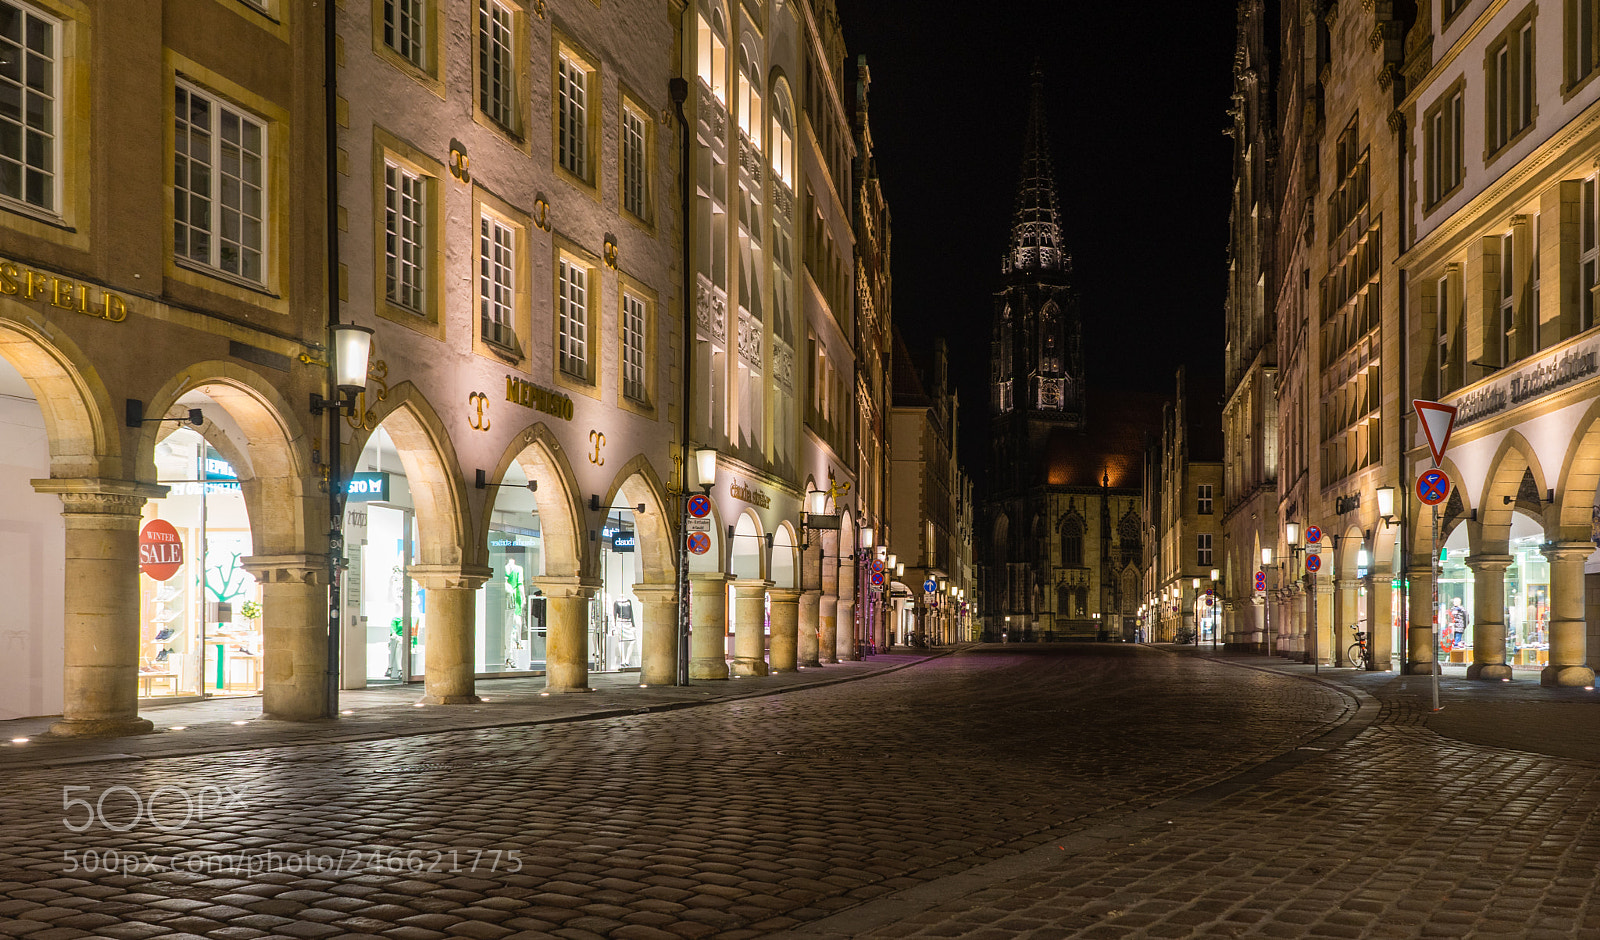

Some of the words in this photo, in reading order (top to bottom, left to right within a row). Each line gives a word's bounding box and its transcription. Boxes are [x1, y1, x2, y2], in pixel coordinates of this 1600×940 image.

[0, 262, 127, 322] SFELD
[505, 376, 574, 421] MEPHISTO
[147, 531, 174, 542] WINTER
[140, 543, 181, 564] SALE
